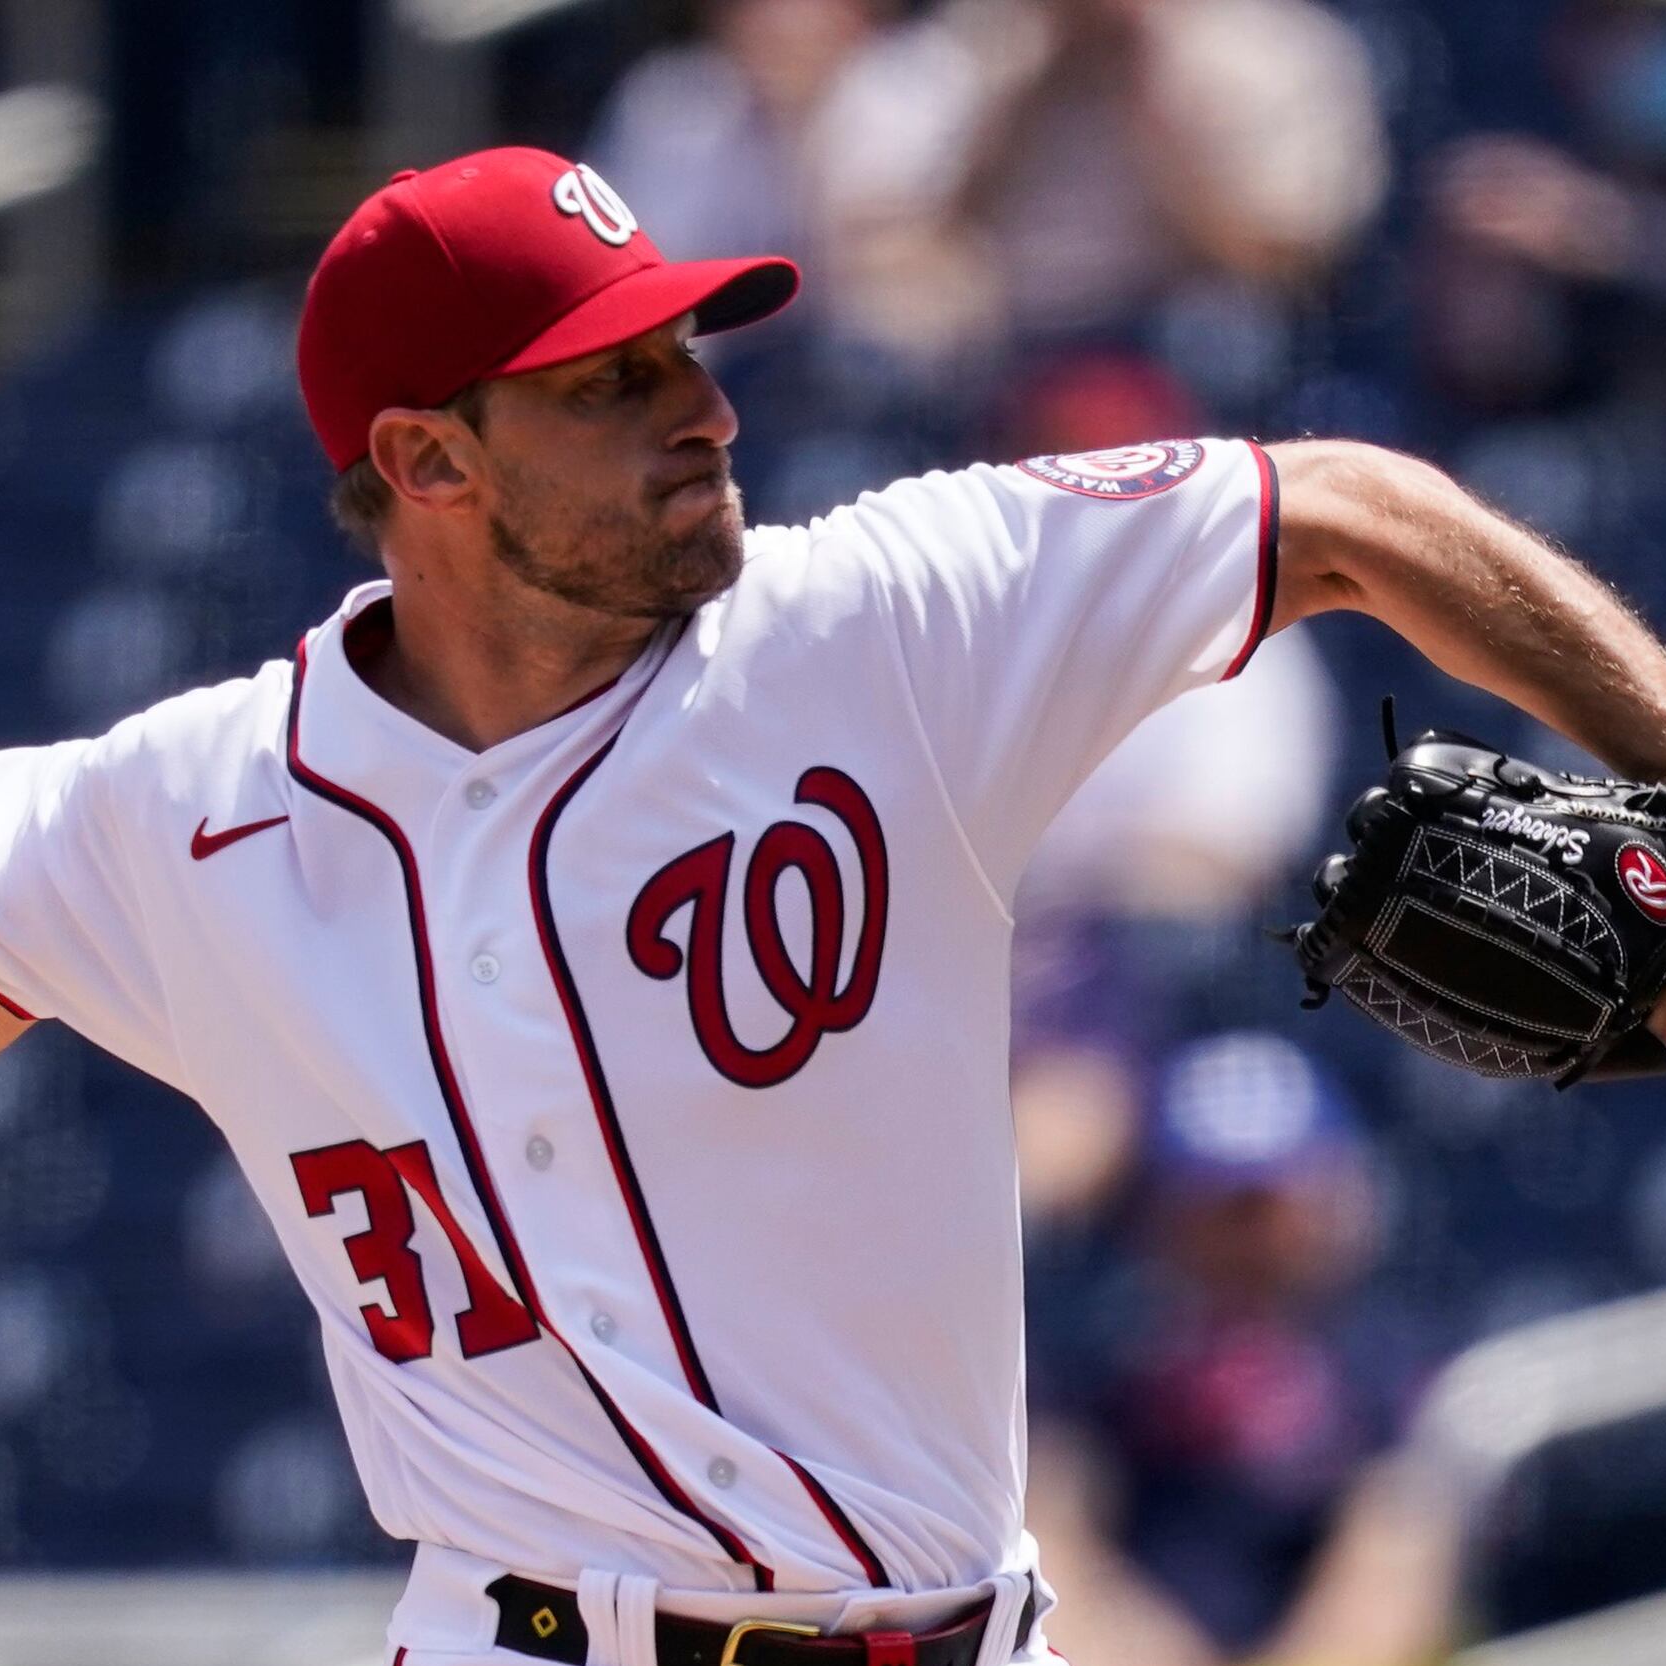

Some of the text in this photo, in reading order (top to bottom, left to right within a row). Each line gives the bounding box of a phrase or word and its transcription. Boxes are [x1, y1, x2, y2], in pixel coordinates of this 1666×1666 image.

[552, 161, 639, 247] W
[1482, 804, 1591, 865] Scherzer
[625, 765, 889, 1089] W
[289, 1138, 542, 1366] 31
